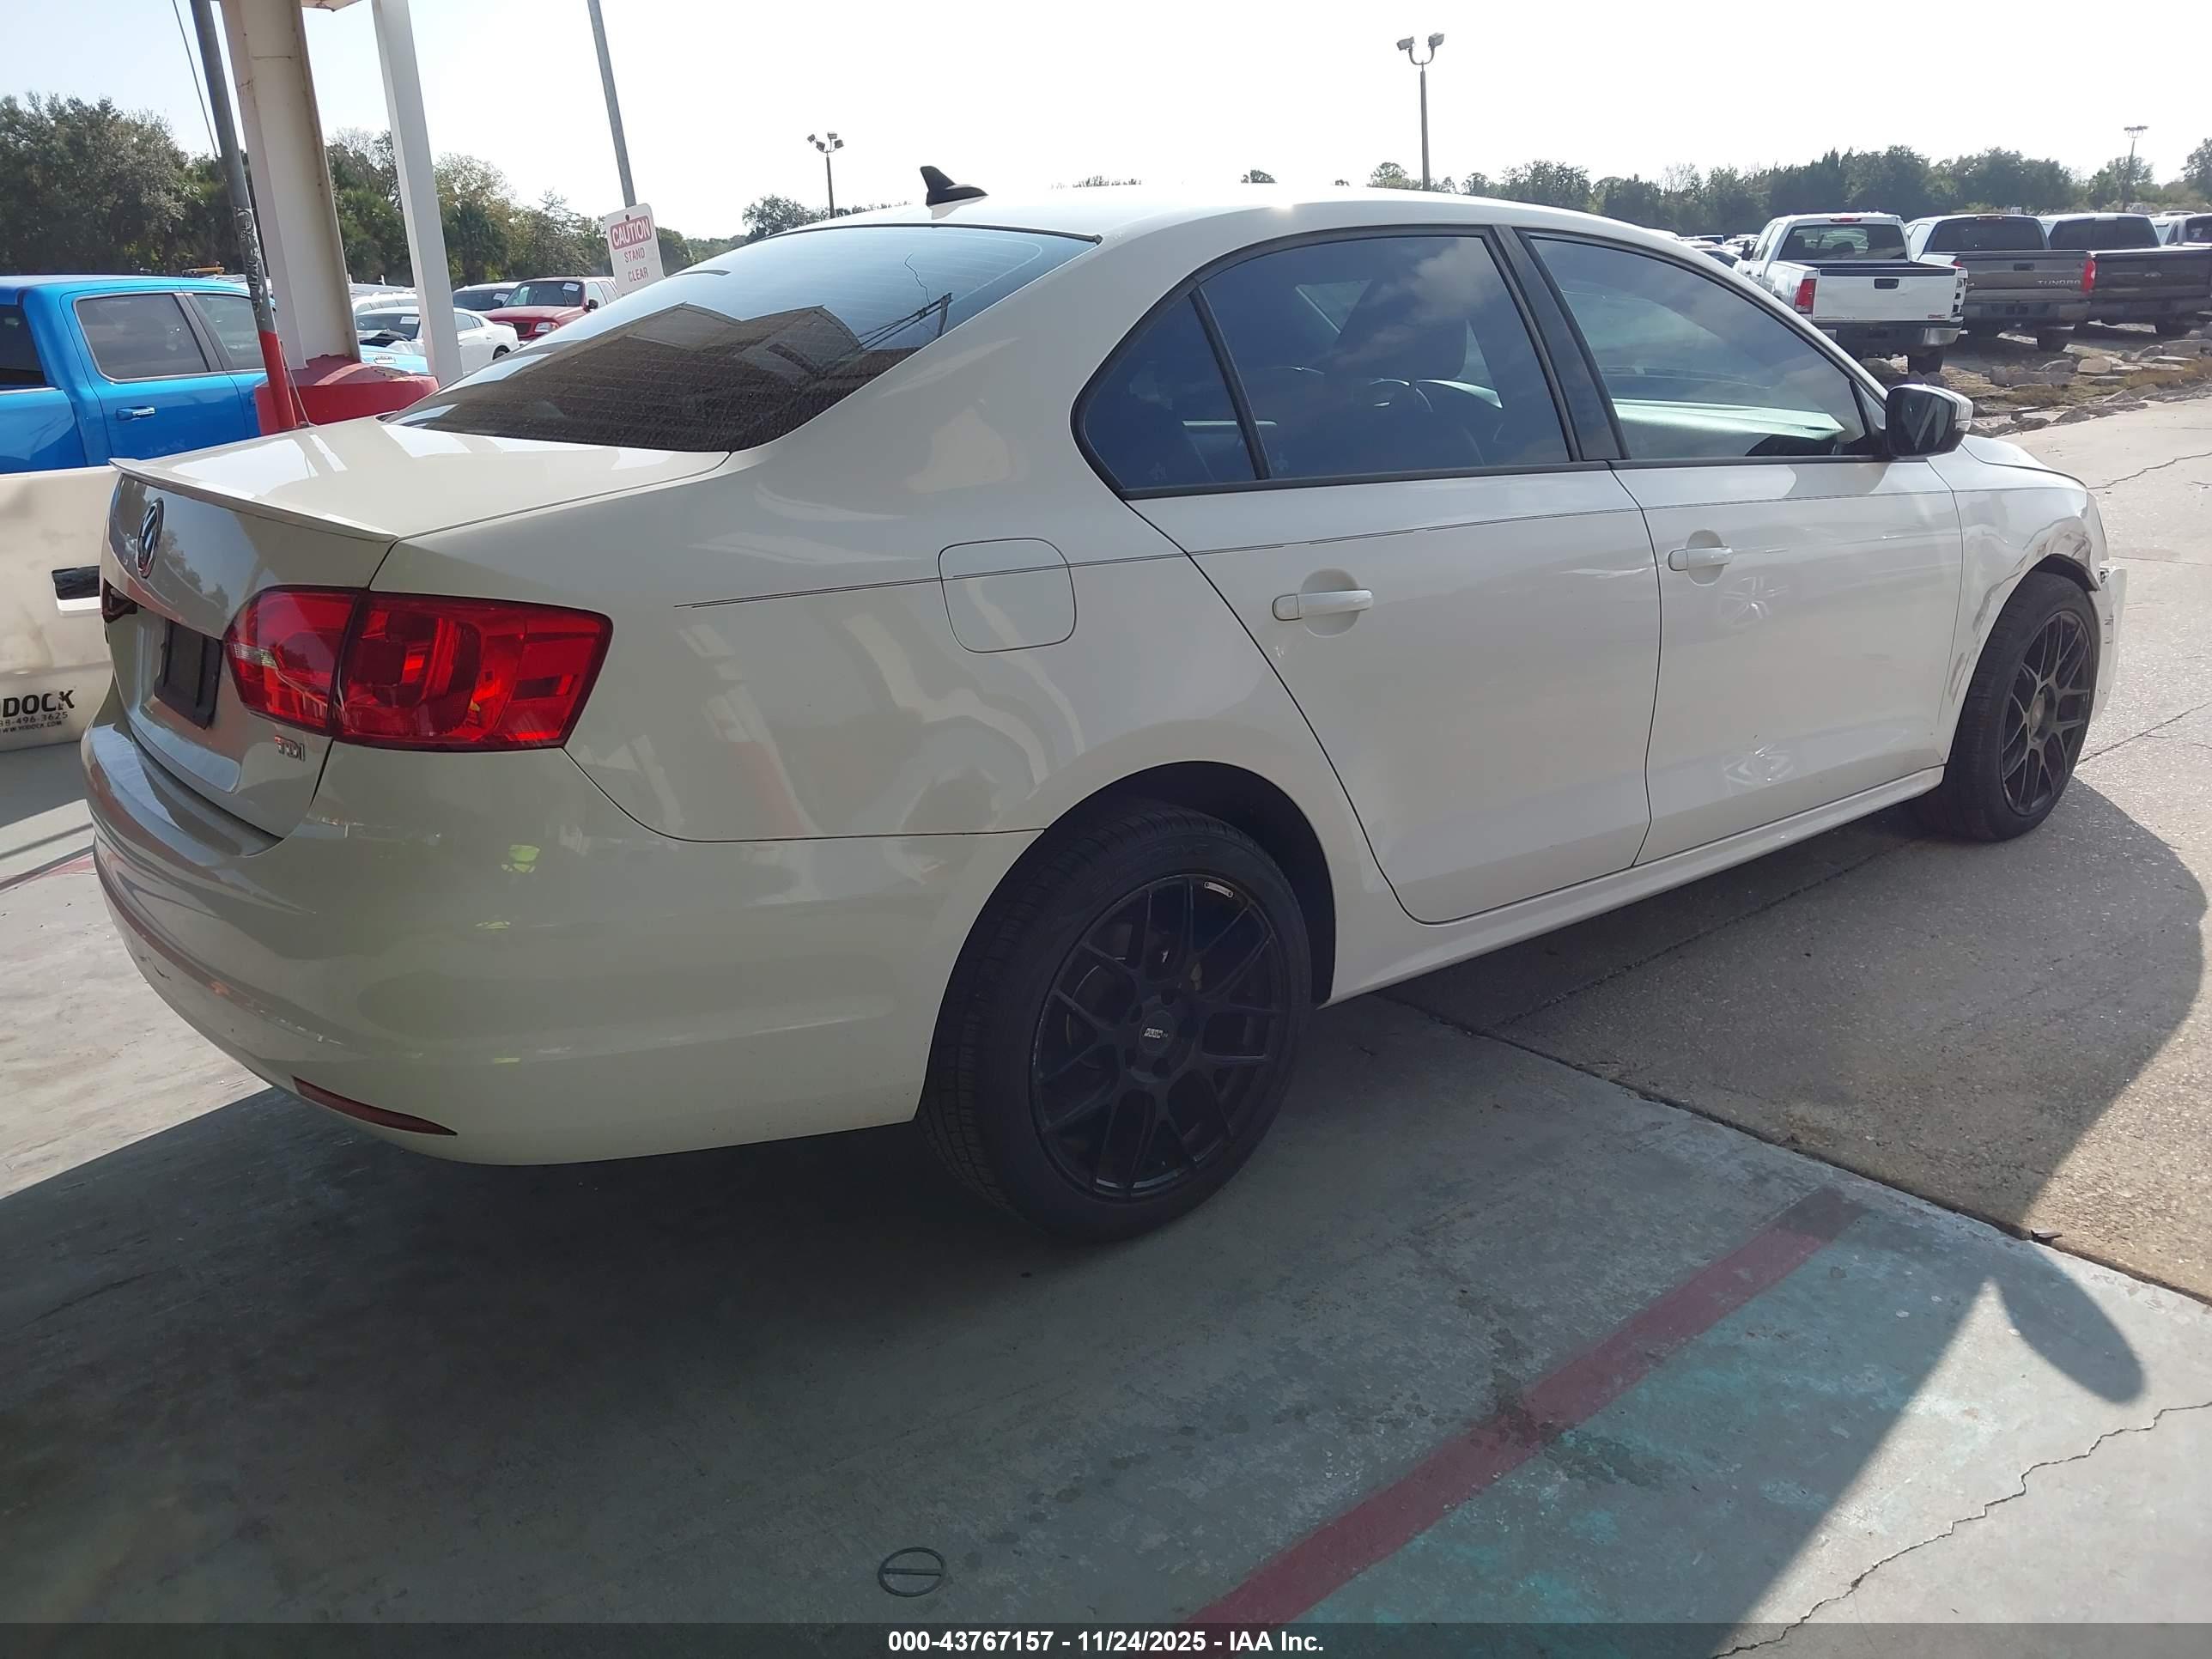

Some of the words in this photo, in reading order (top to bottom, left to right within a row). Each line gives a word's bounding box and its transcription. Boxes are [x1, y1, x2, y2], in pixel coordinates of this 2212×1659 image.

[611, 218, 651, 247] CAUTION
[623, 246, 646, 263] STAND
[628, 267, 649, 283] CLEAR
[0, 690, 76, 718] DOCK
